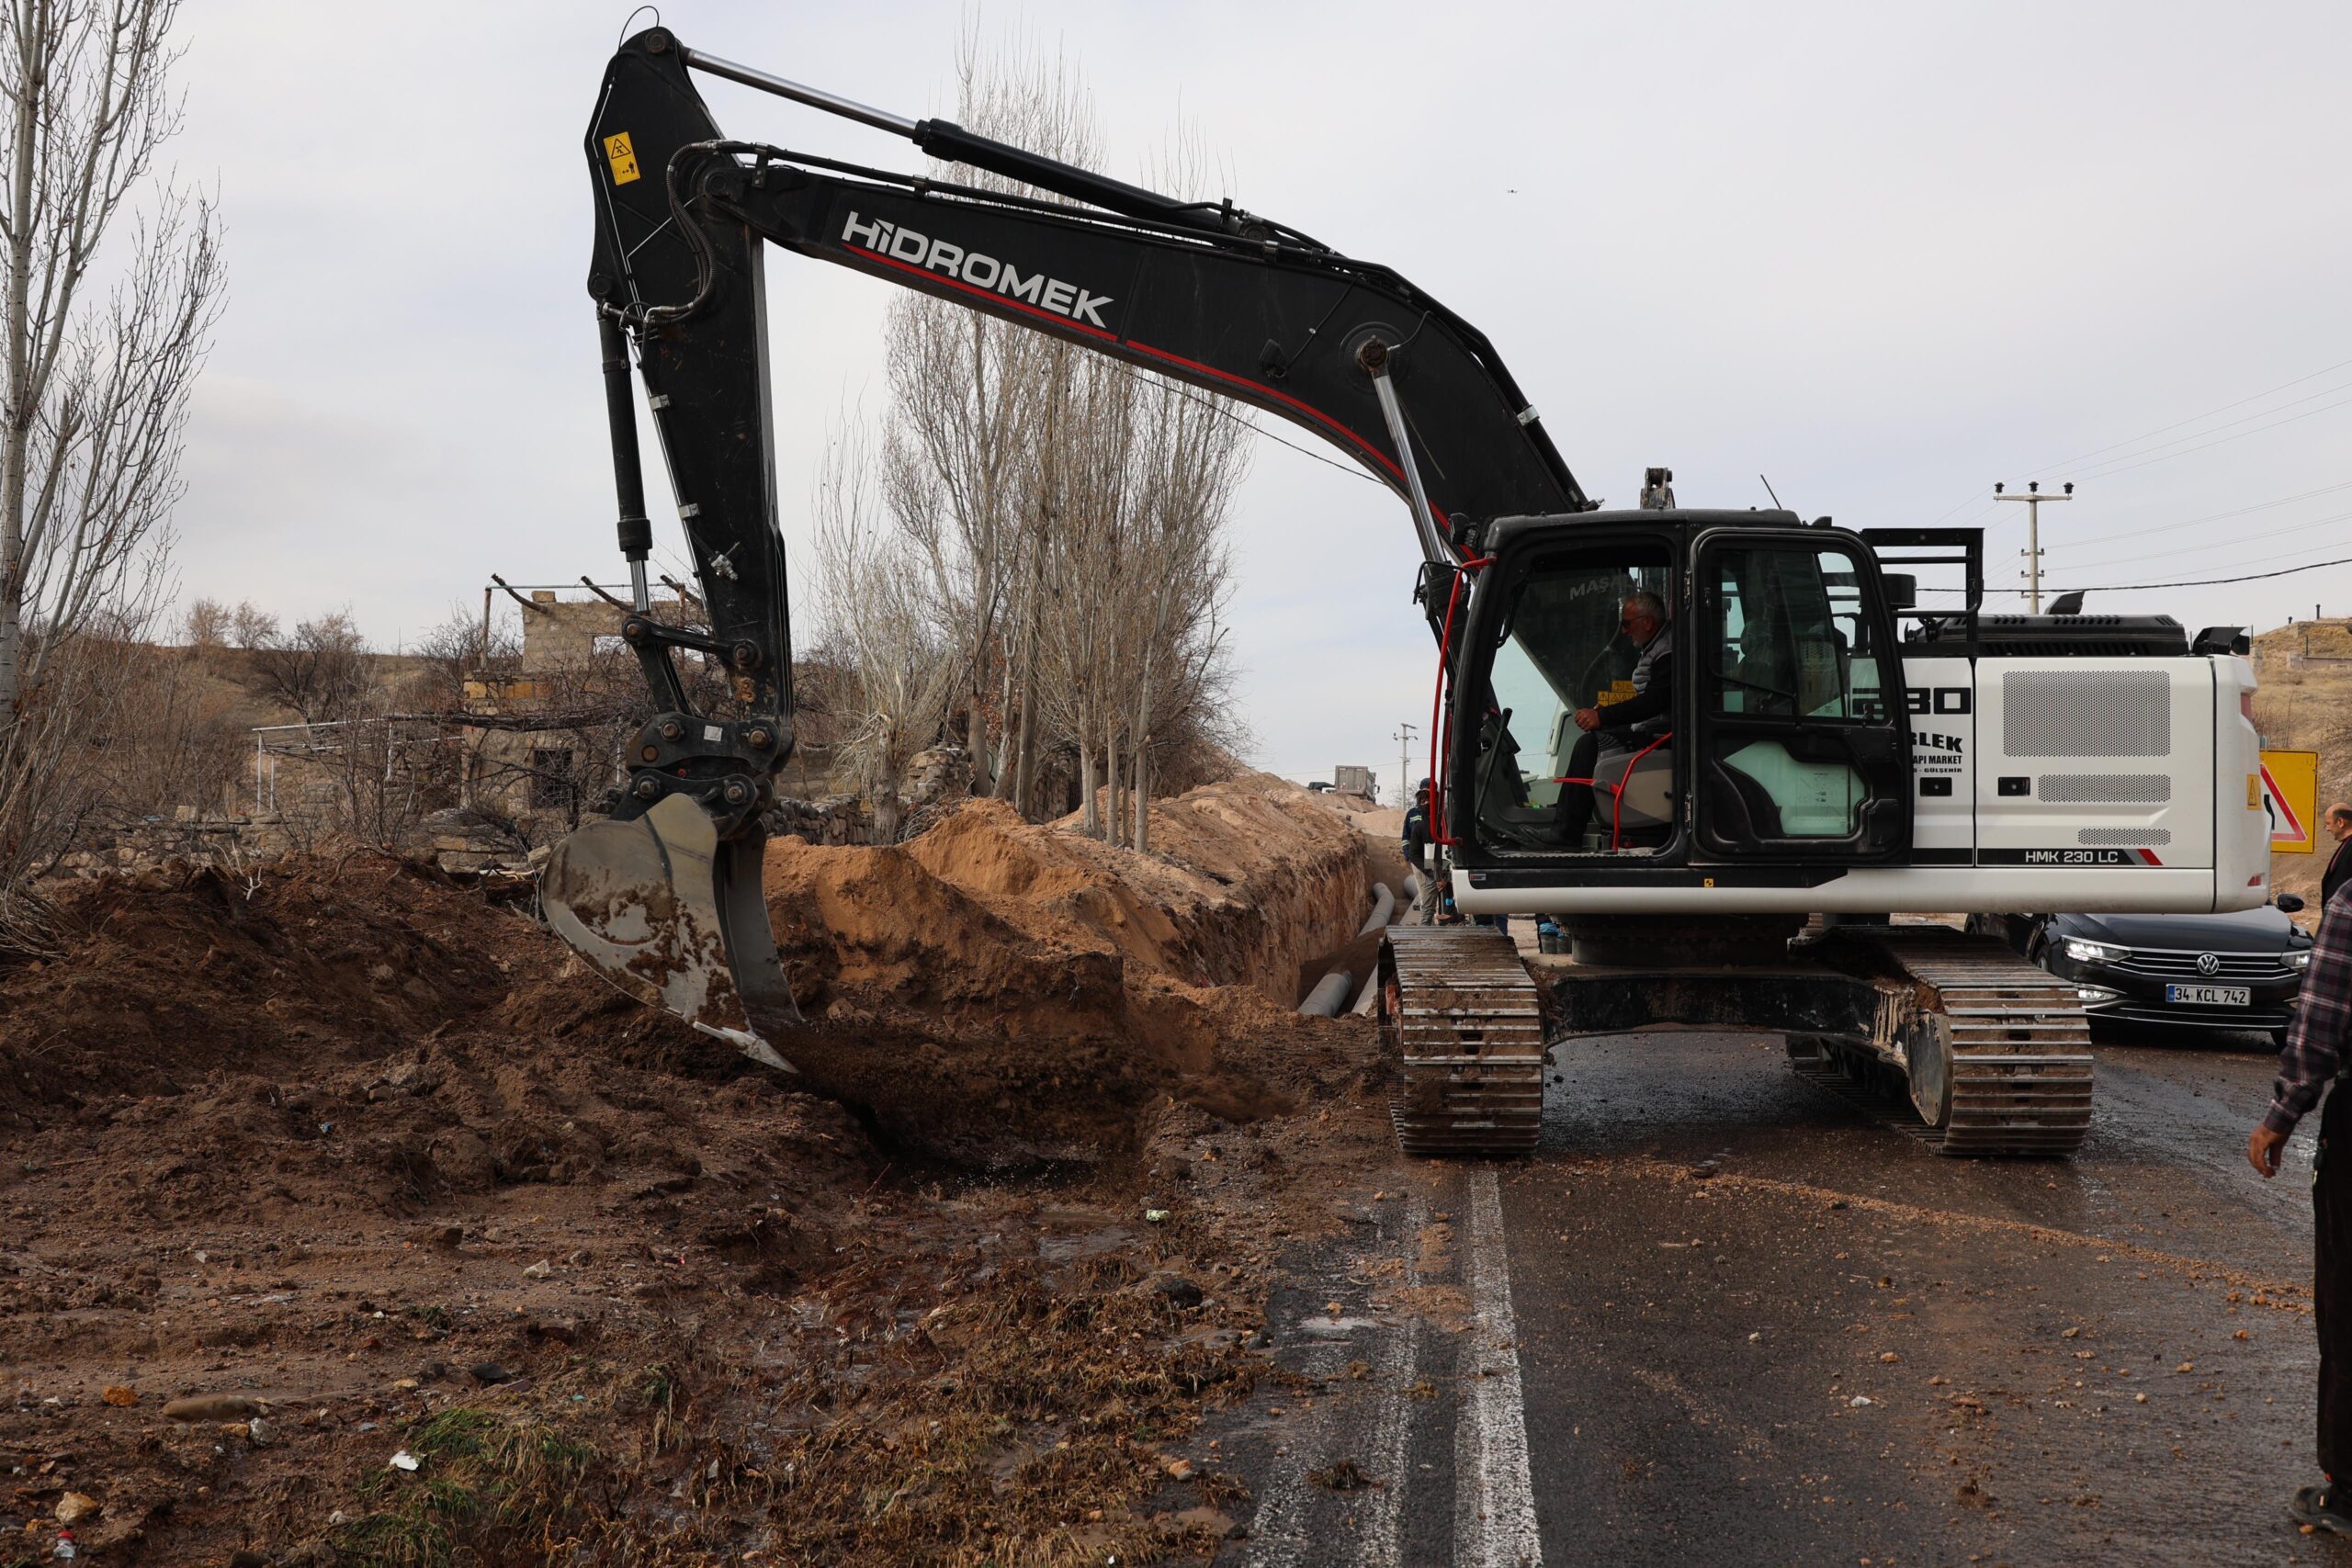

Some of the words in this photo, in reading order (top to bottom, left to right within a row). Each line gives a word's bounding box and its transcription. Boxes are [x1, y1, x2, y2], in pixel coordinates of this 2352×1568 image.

[1928, 755, 1962, 764] MARKET
[2025, 851, 2059, 863] HMK
[2064, 851, 2093, 863] 230
[2098, 851, 2118, 863] LC
[2176, 987, 2189, 1000] 34
[2197, 989, 2218, 1002] KCL
[2223, 991, 2245, 1003] 742
